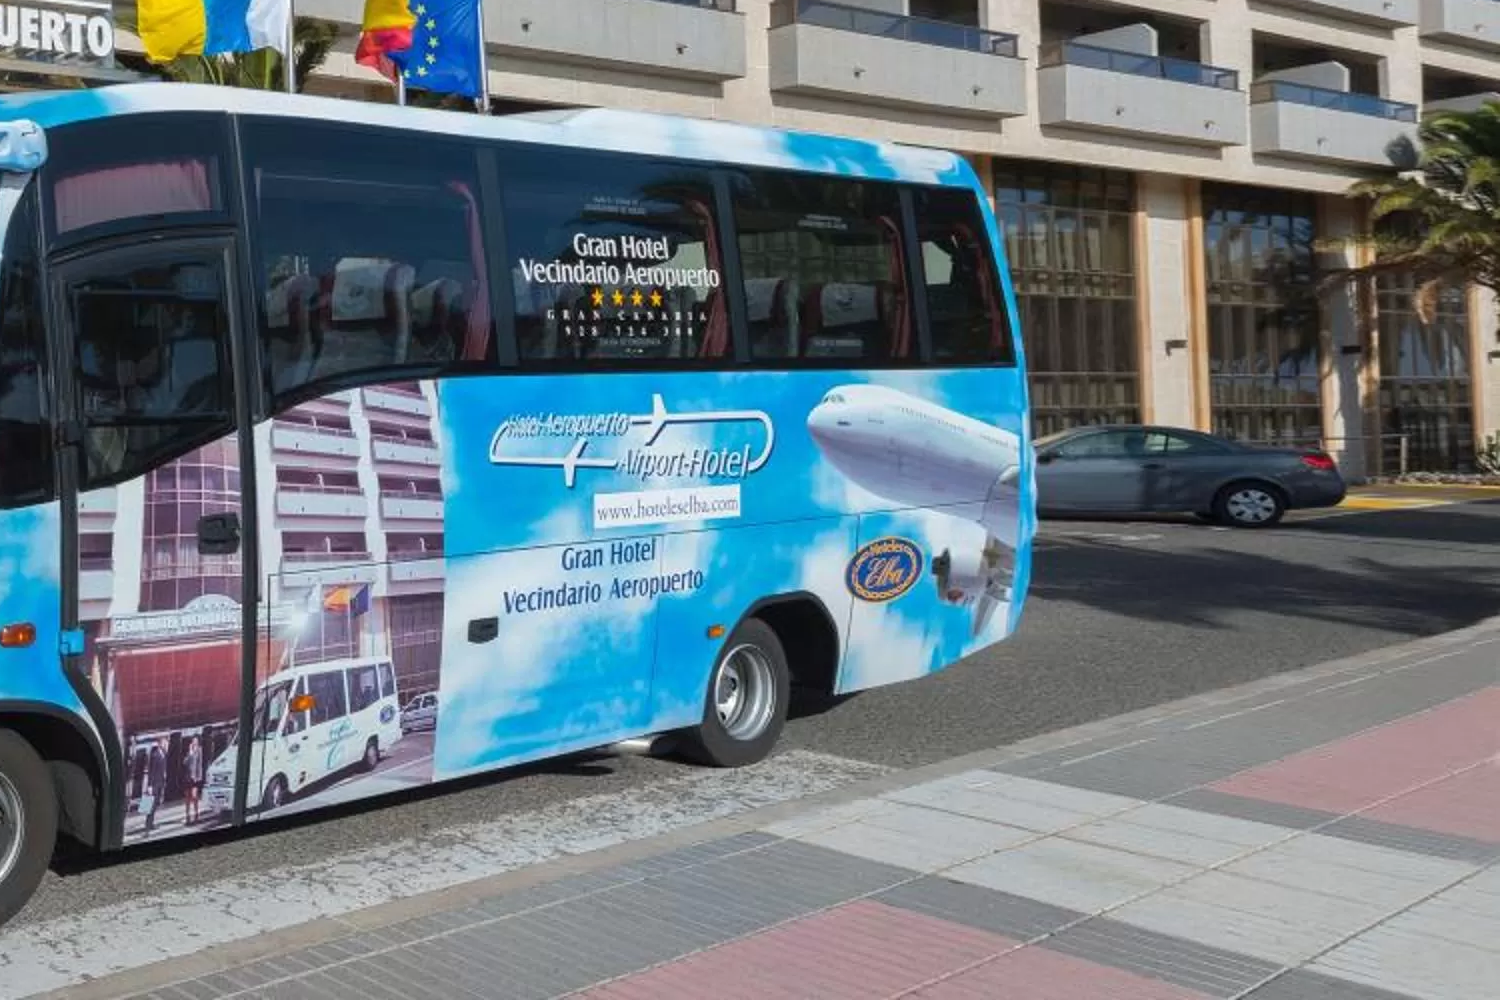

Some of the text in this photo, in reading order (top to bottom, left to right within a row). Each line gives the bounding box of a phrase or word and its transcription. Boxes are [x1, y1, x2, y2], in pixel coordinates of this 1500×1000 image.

[573, 232, 669, 259] Gran Hotel
[520, 258, 720, 289] Vecindario Aeropuerto
[618, 444, 749, 481] Airport-Hotel
[598, 495, 738, 520] www.hoteleselba.com
[562, 536, 656, 571] Gran Hotel
[503, 569, 704, 614] Vecindario Aeropuerto
